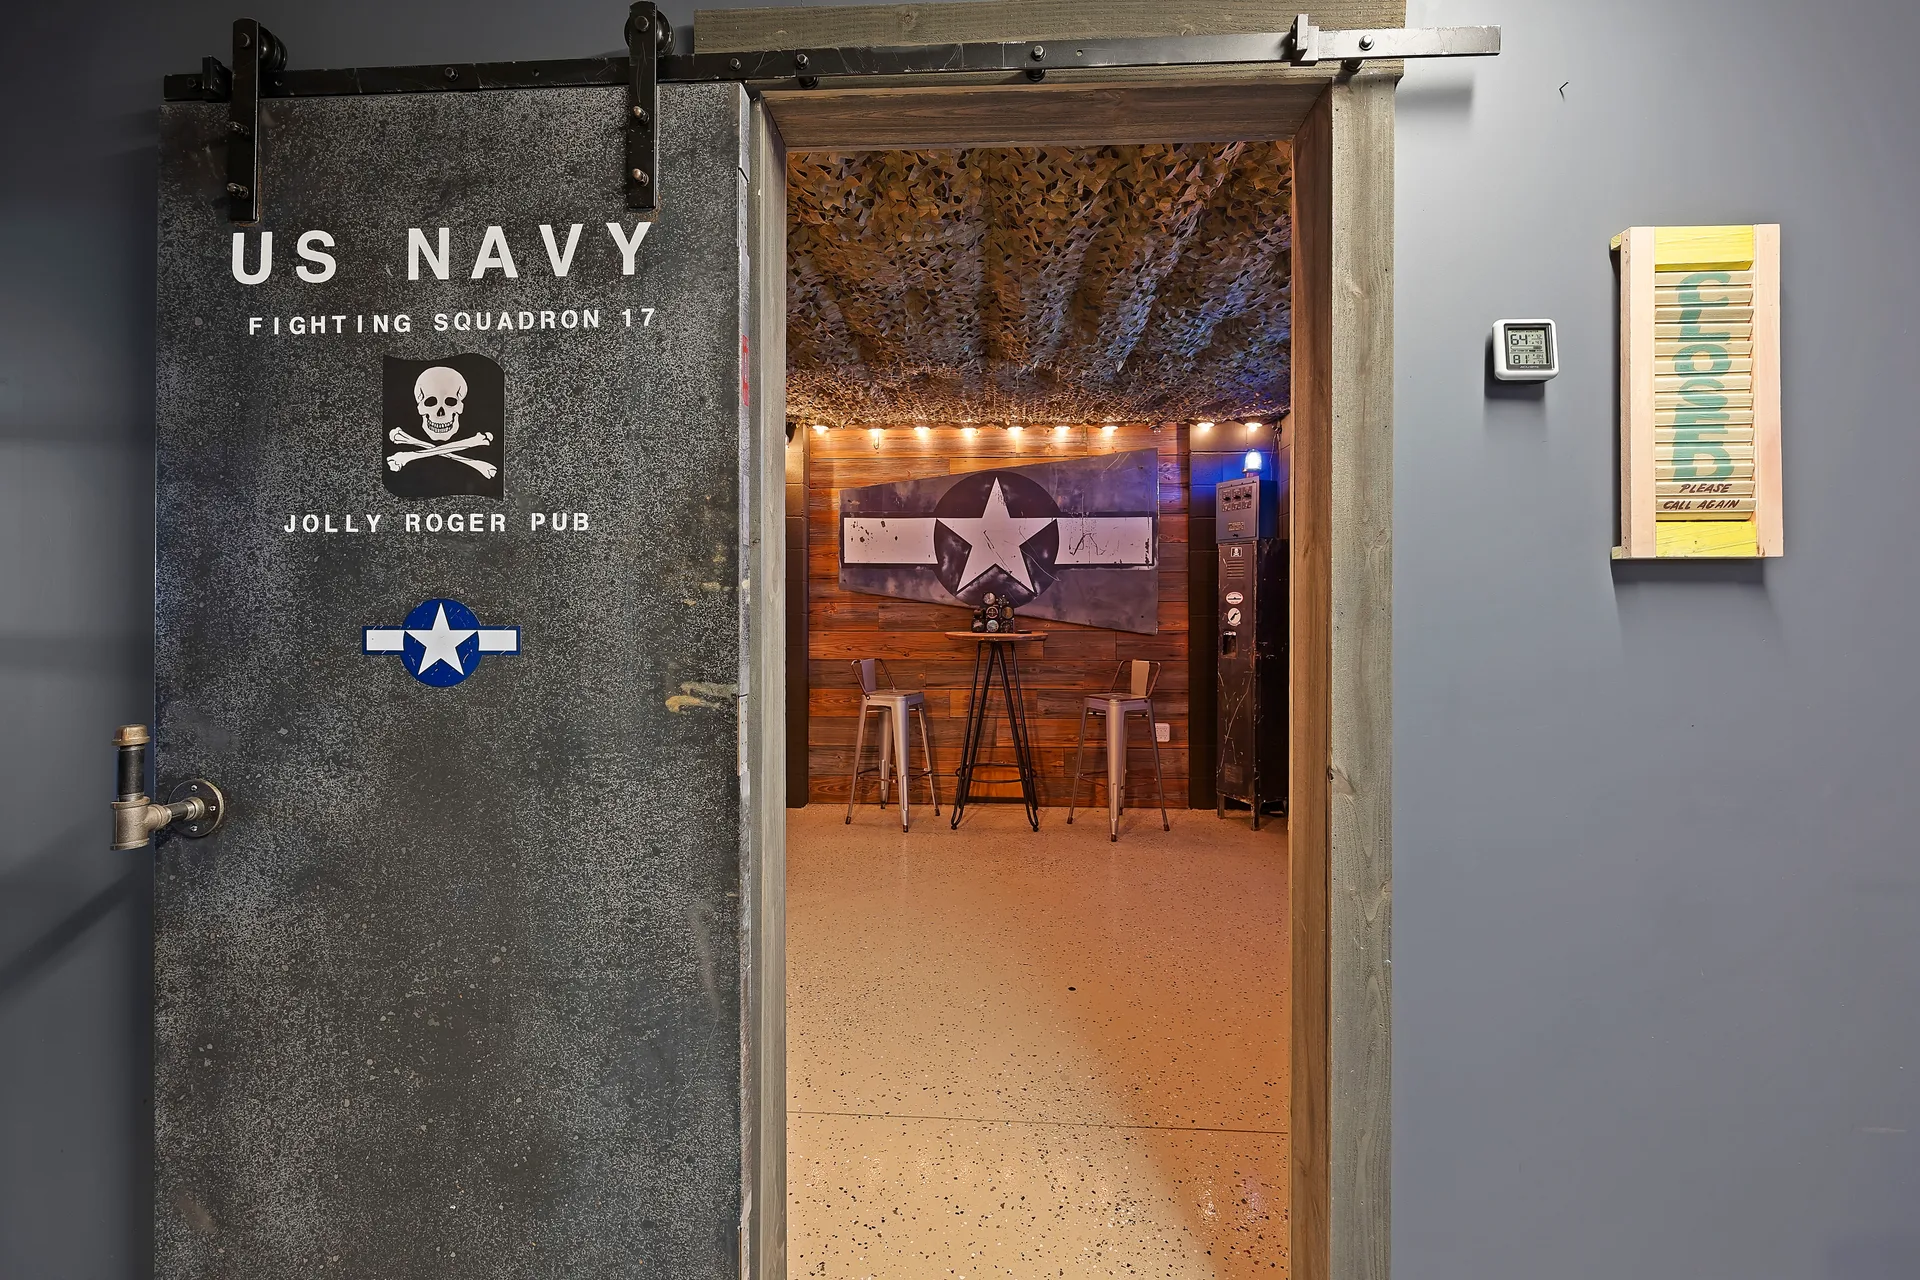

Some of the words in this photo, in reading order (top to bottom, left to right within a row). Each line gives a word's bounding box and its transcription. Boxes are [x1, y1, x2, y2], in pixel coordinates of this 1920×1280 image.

[232, 230, 336, 284] US
[408, 222, 651, 280] NAVY
[249, 314, 411, 336] FIGHTING
[433, 308, 601, 332] SQUADRON
[621, 308, 656, 328] 17
[1510, 334, 1528, 345] 64
[1513, 354, 1528, 364] 81
[1672, 273, 1735, 482] CLOSED
[1679, 483, 1732, 494] PLEASE
[1663, 500, 1691, 511] CALL
[1697, 499, 1740, 510] AGAIN
[284, 513, 382, 533] JOLLY
[406, 512, 507, 532] ROGER
[531, 510, 589, 532] PUB
